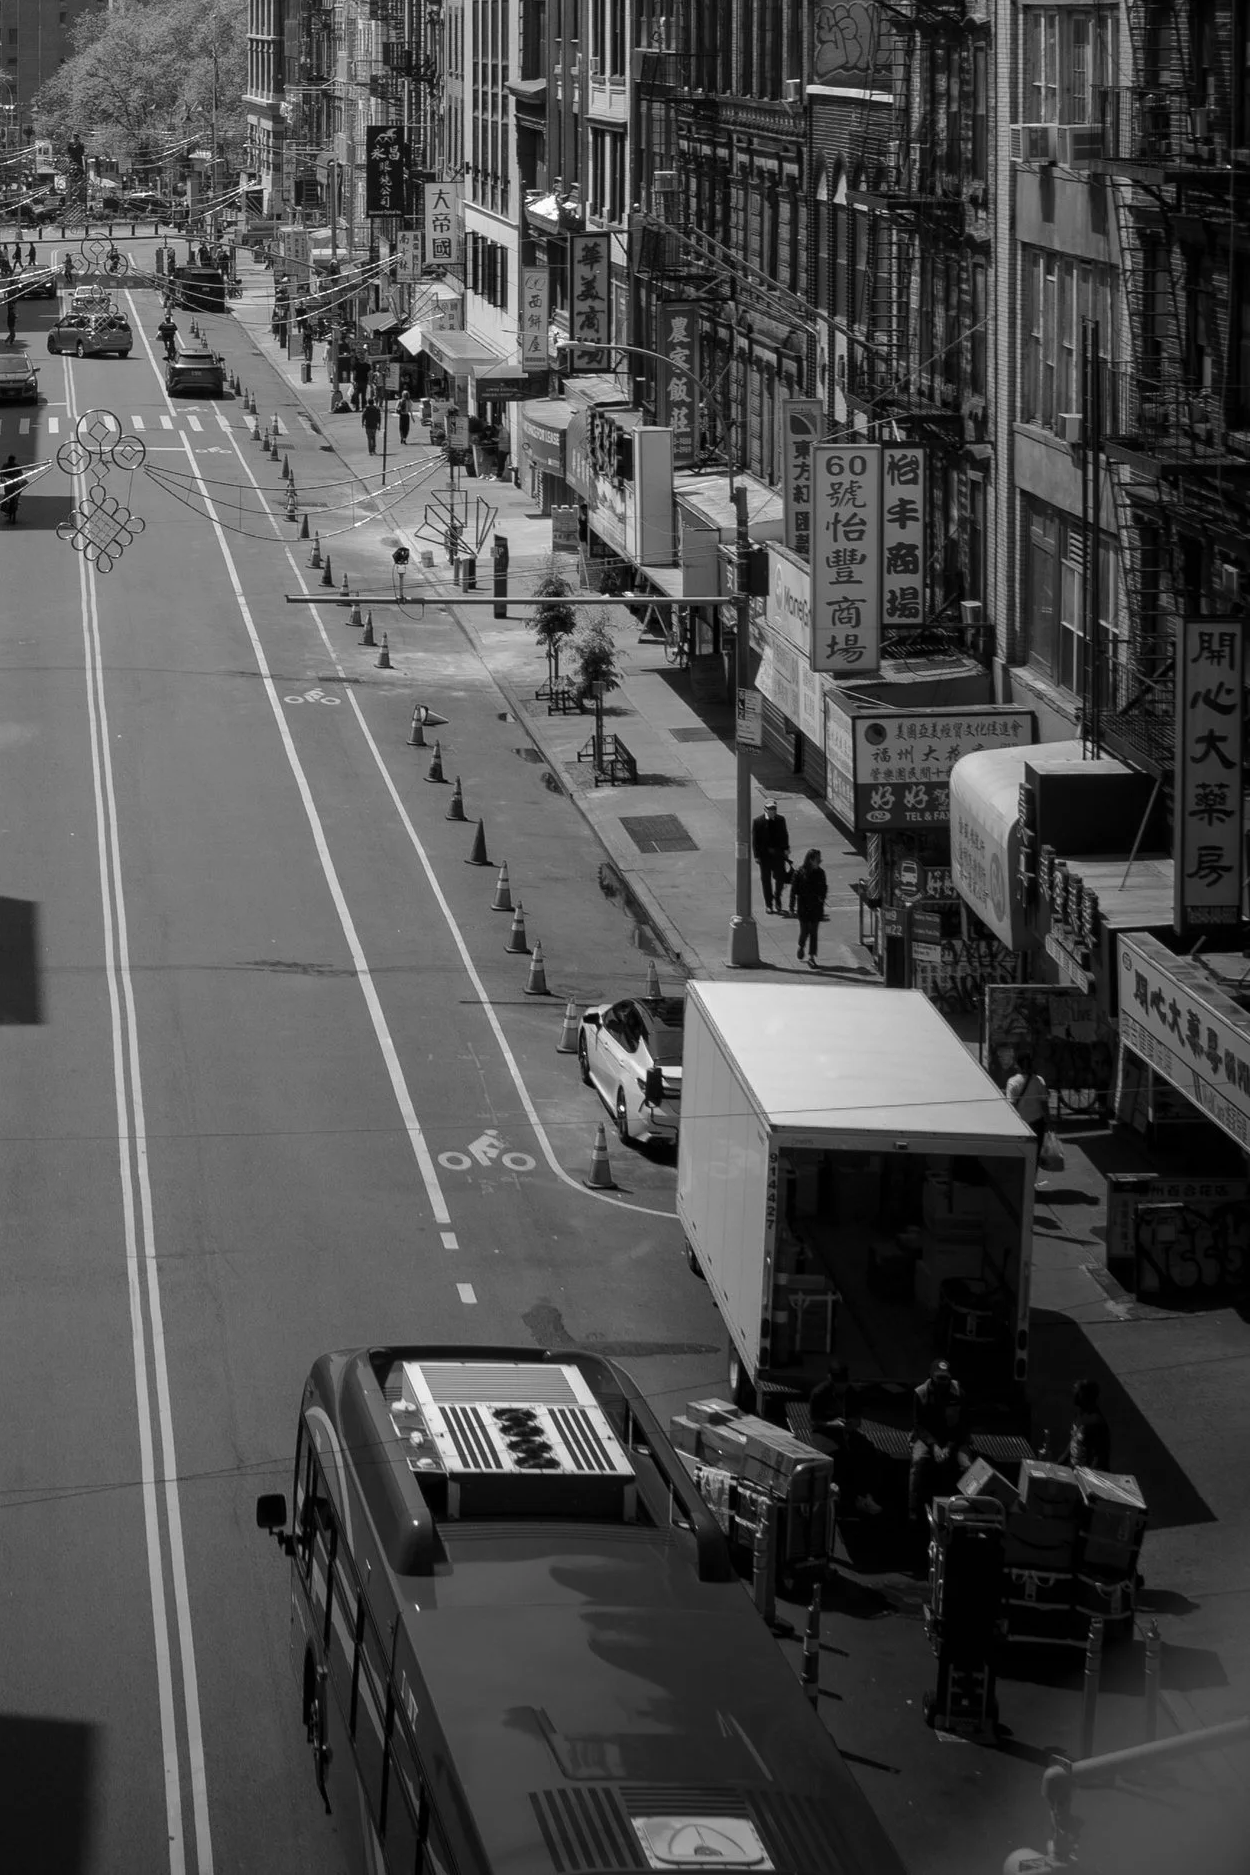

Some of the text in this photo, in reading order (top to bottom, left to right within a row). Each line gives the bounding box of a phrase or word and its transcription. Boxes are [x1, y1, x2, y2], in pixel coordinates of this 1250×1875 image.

[430, 188, 452, 259] 大帝國
[666, 316, 692, 434] 農家飯莊
[825, 454, 867, 664] 60號怡豐商場
[1187, 631, 1237, 888] 開心大藥房
[905, 812, 950, 821] TEL & FAX
[766, 1152, 778, 1230] 914427
